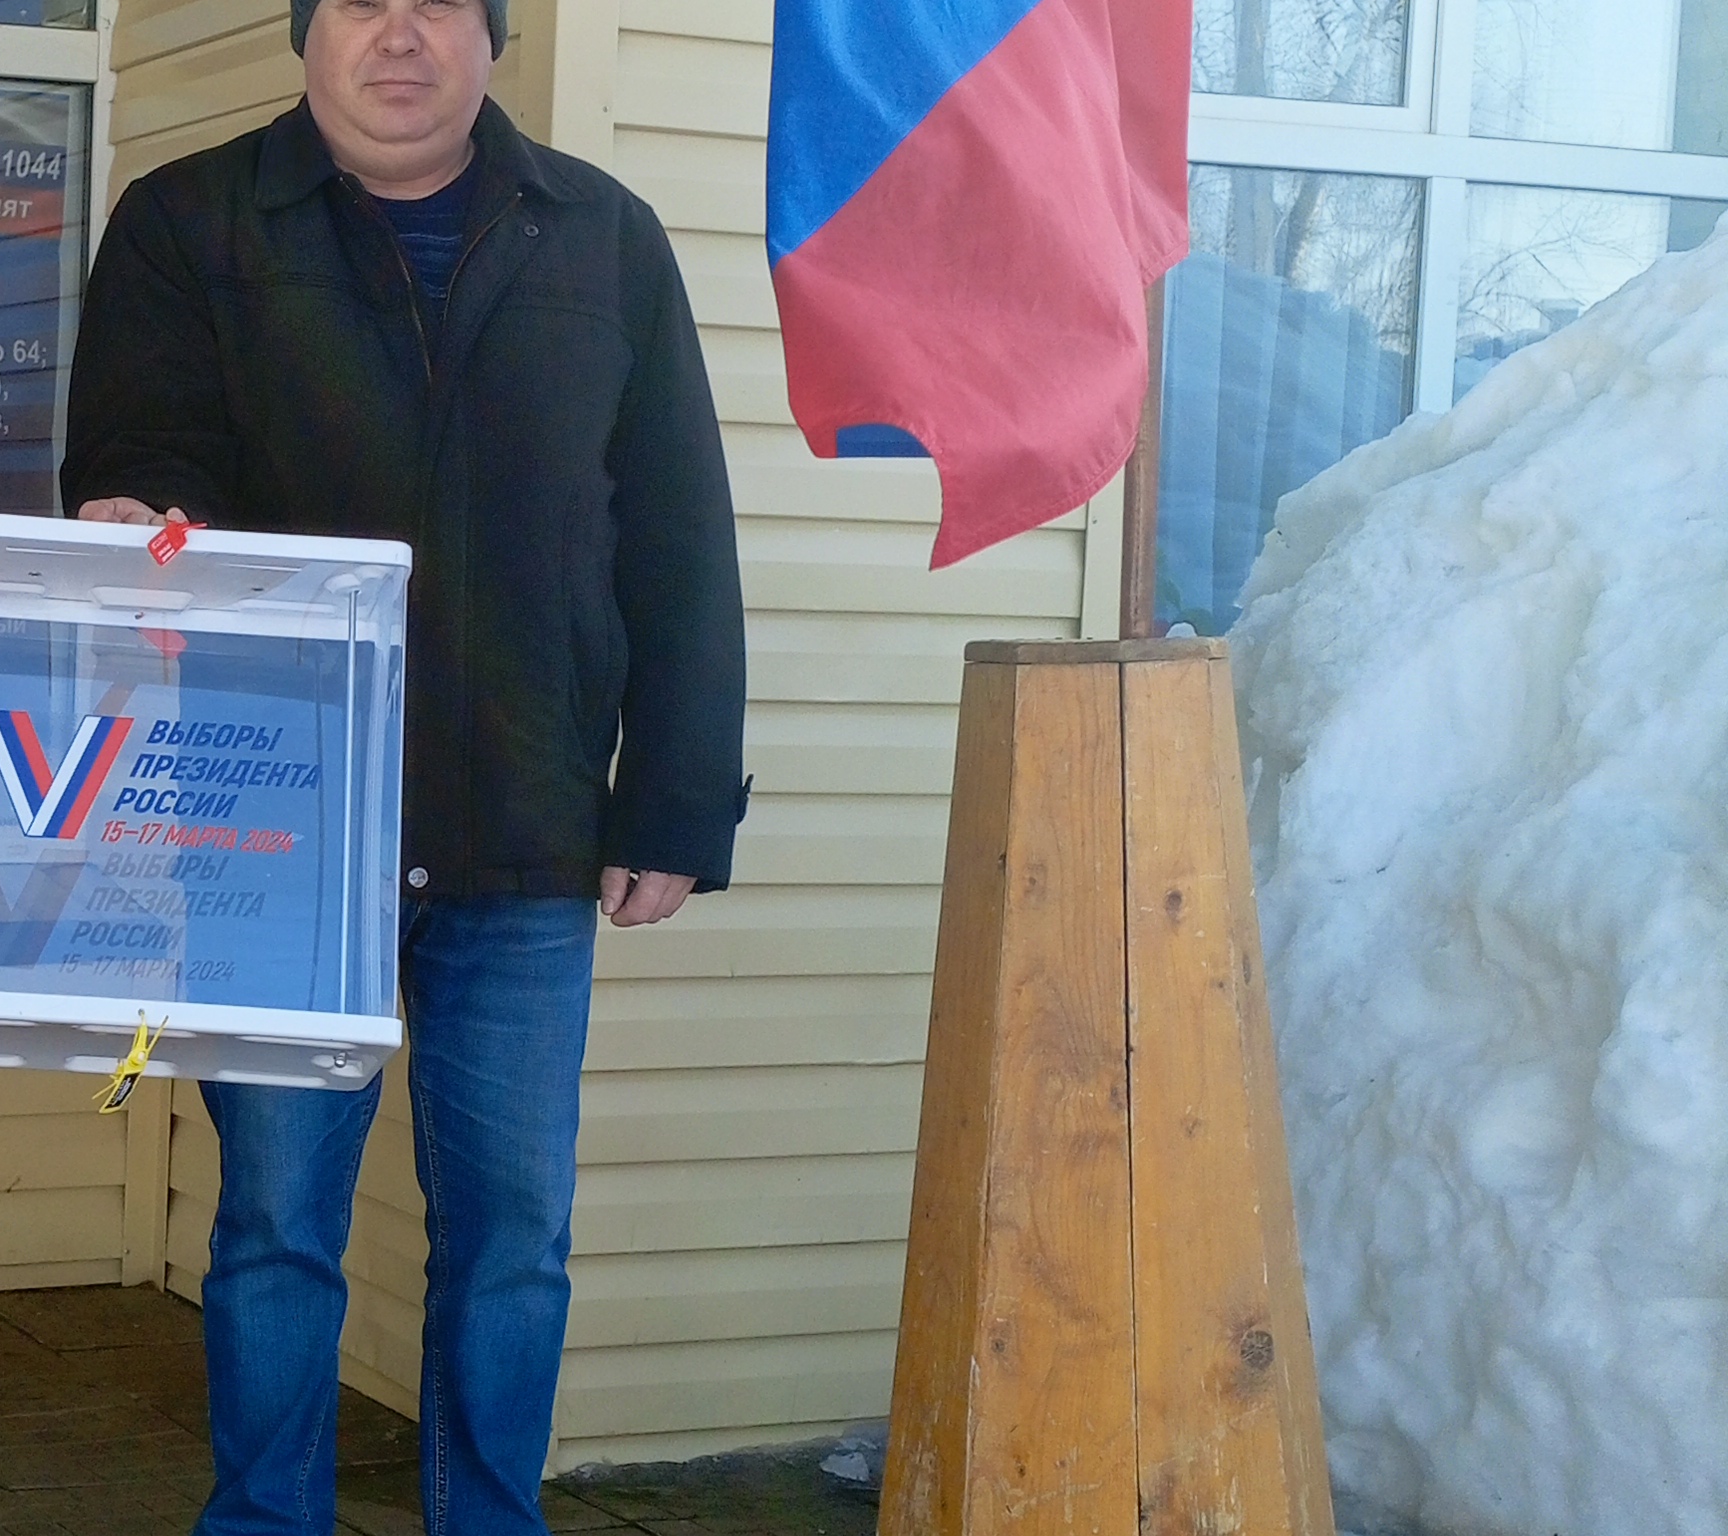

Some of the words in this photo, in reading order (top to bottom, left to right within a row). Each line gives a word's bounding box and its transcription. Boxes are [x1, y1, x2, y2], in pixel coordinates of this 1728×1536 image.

[3, 149, 61, 180] 1044
[13, 339, 47, 368] 64;
[146, 720, 283, 752] ВЫБОРЫ
[129, 753, 320, 790] ПРЕЗИДЕНТА
[113, 787, 238, 818] РОССИИ
[162, 824, 238, 850] МАРТА
[240, 829, 294, 854] 2024
